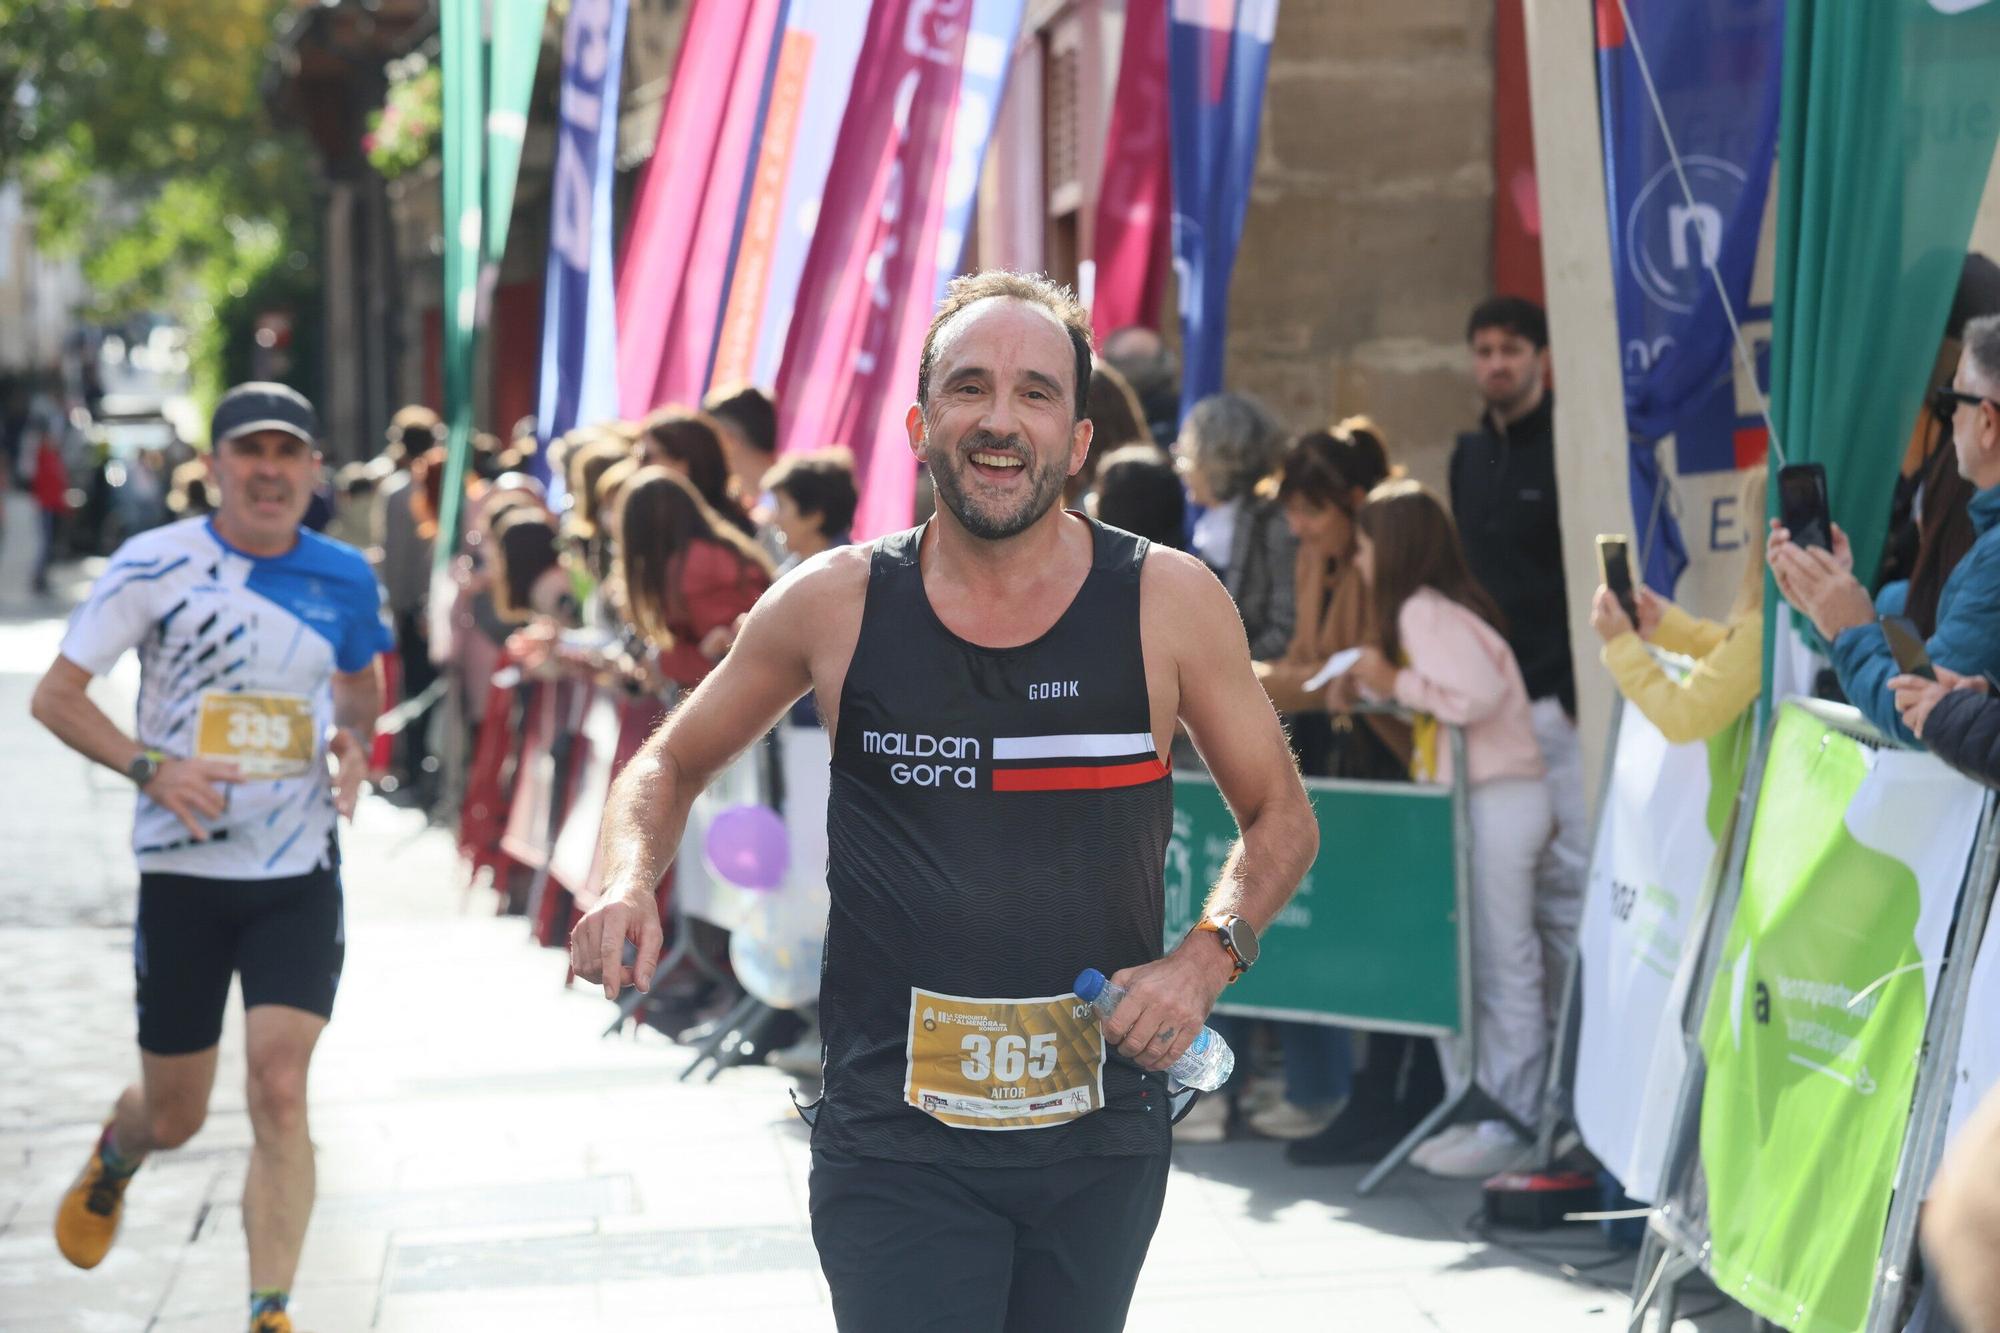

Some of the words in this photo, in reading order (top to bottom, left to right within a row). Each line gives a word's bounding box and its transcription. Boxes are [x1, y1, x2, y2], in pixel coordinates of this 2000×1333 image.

[1028, 680, 1080, 701] GOBIK
[227, 712, 290, 751] 335
[960, 1032, 1058, 1082] 365
[991, 1087, 1027, 1100] AITOR
